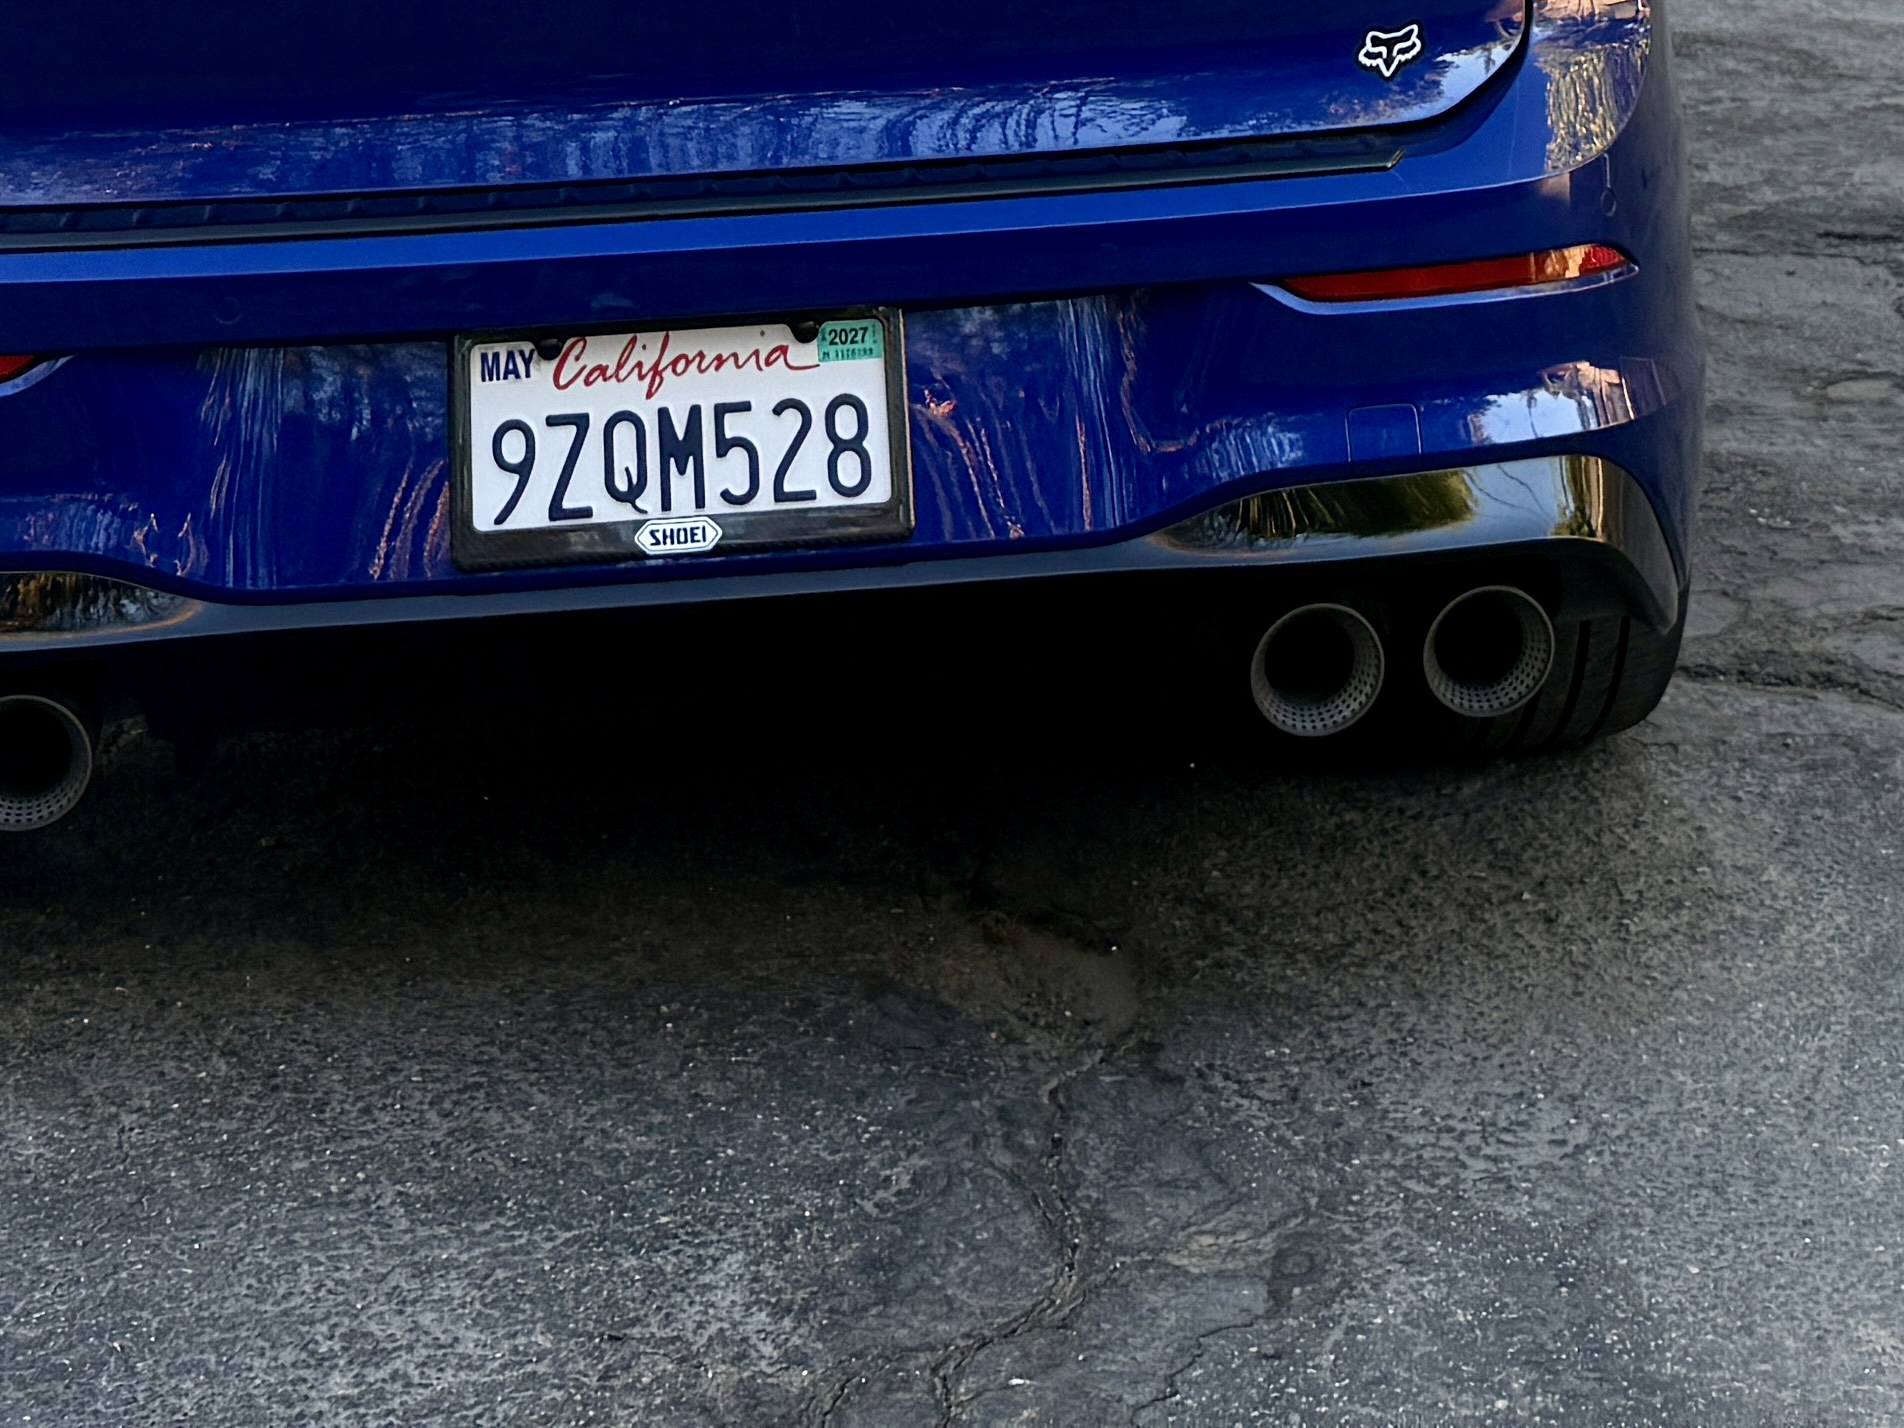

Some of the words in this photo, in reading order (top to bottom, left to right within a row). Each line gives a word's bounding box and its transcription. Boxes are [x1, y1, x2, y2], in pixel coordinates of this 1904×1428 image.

[480, 348, 536, 383] MAY
[553, 331, 820, 401] California
[828, 327, 869, 346] 2027
[492, 393, 873, 526] 9ZQM528
[649, 525, 707, 546] SHOEI
